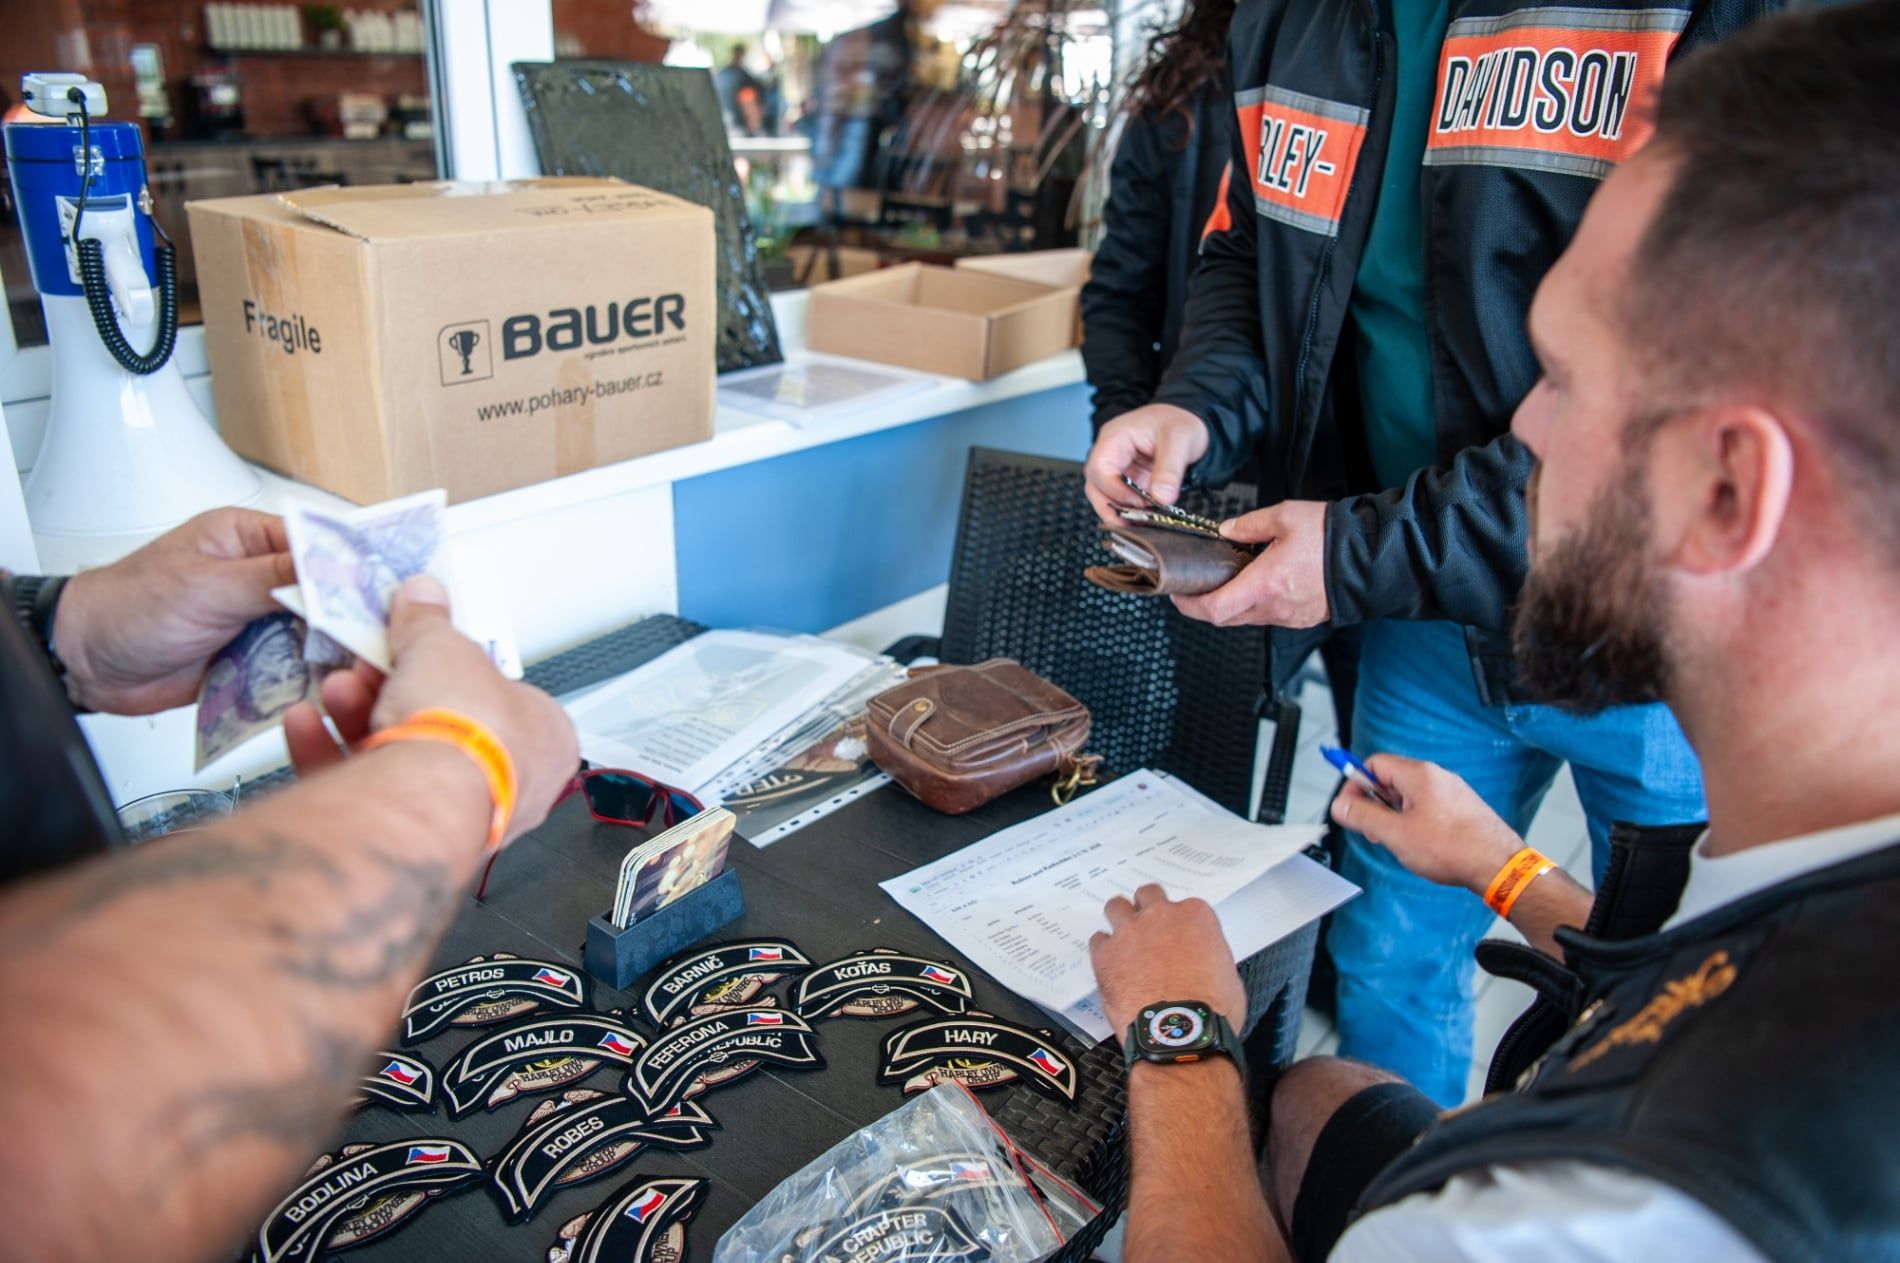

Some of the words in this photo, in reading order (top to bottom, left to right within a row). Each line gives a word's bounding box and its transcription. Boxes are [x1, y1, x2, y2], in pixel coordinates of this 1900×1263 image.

[1436, 47, 1637, 140] DAVIDSON
[477, 371, 664, 421] www.pohary-bauer.cz
[435, 968, 504, 992] PETROS
[662, 955, 724, 994] BARNIČ
[833, 961, 892, 980] KOŤAS
[504, 1030, 574, 1052] MAJLO
[648, 1021, 729, 1070] FEFERONA
[944, 1029, 998, 1046] HARY
[542, 1116, 604, 1159] ROBES
[284, 1162, 379, 1223] BODLINA
